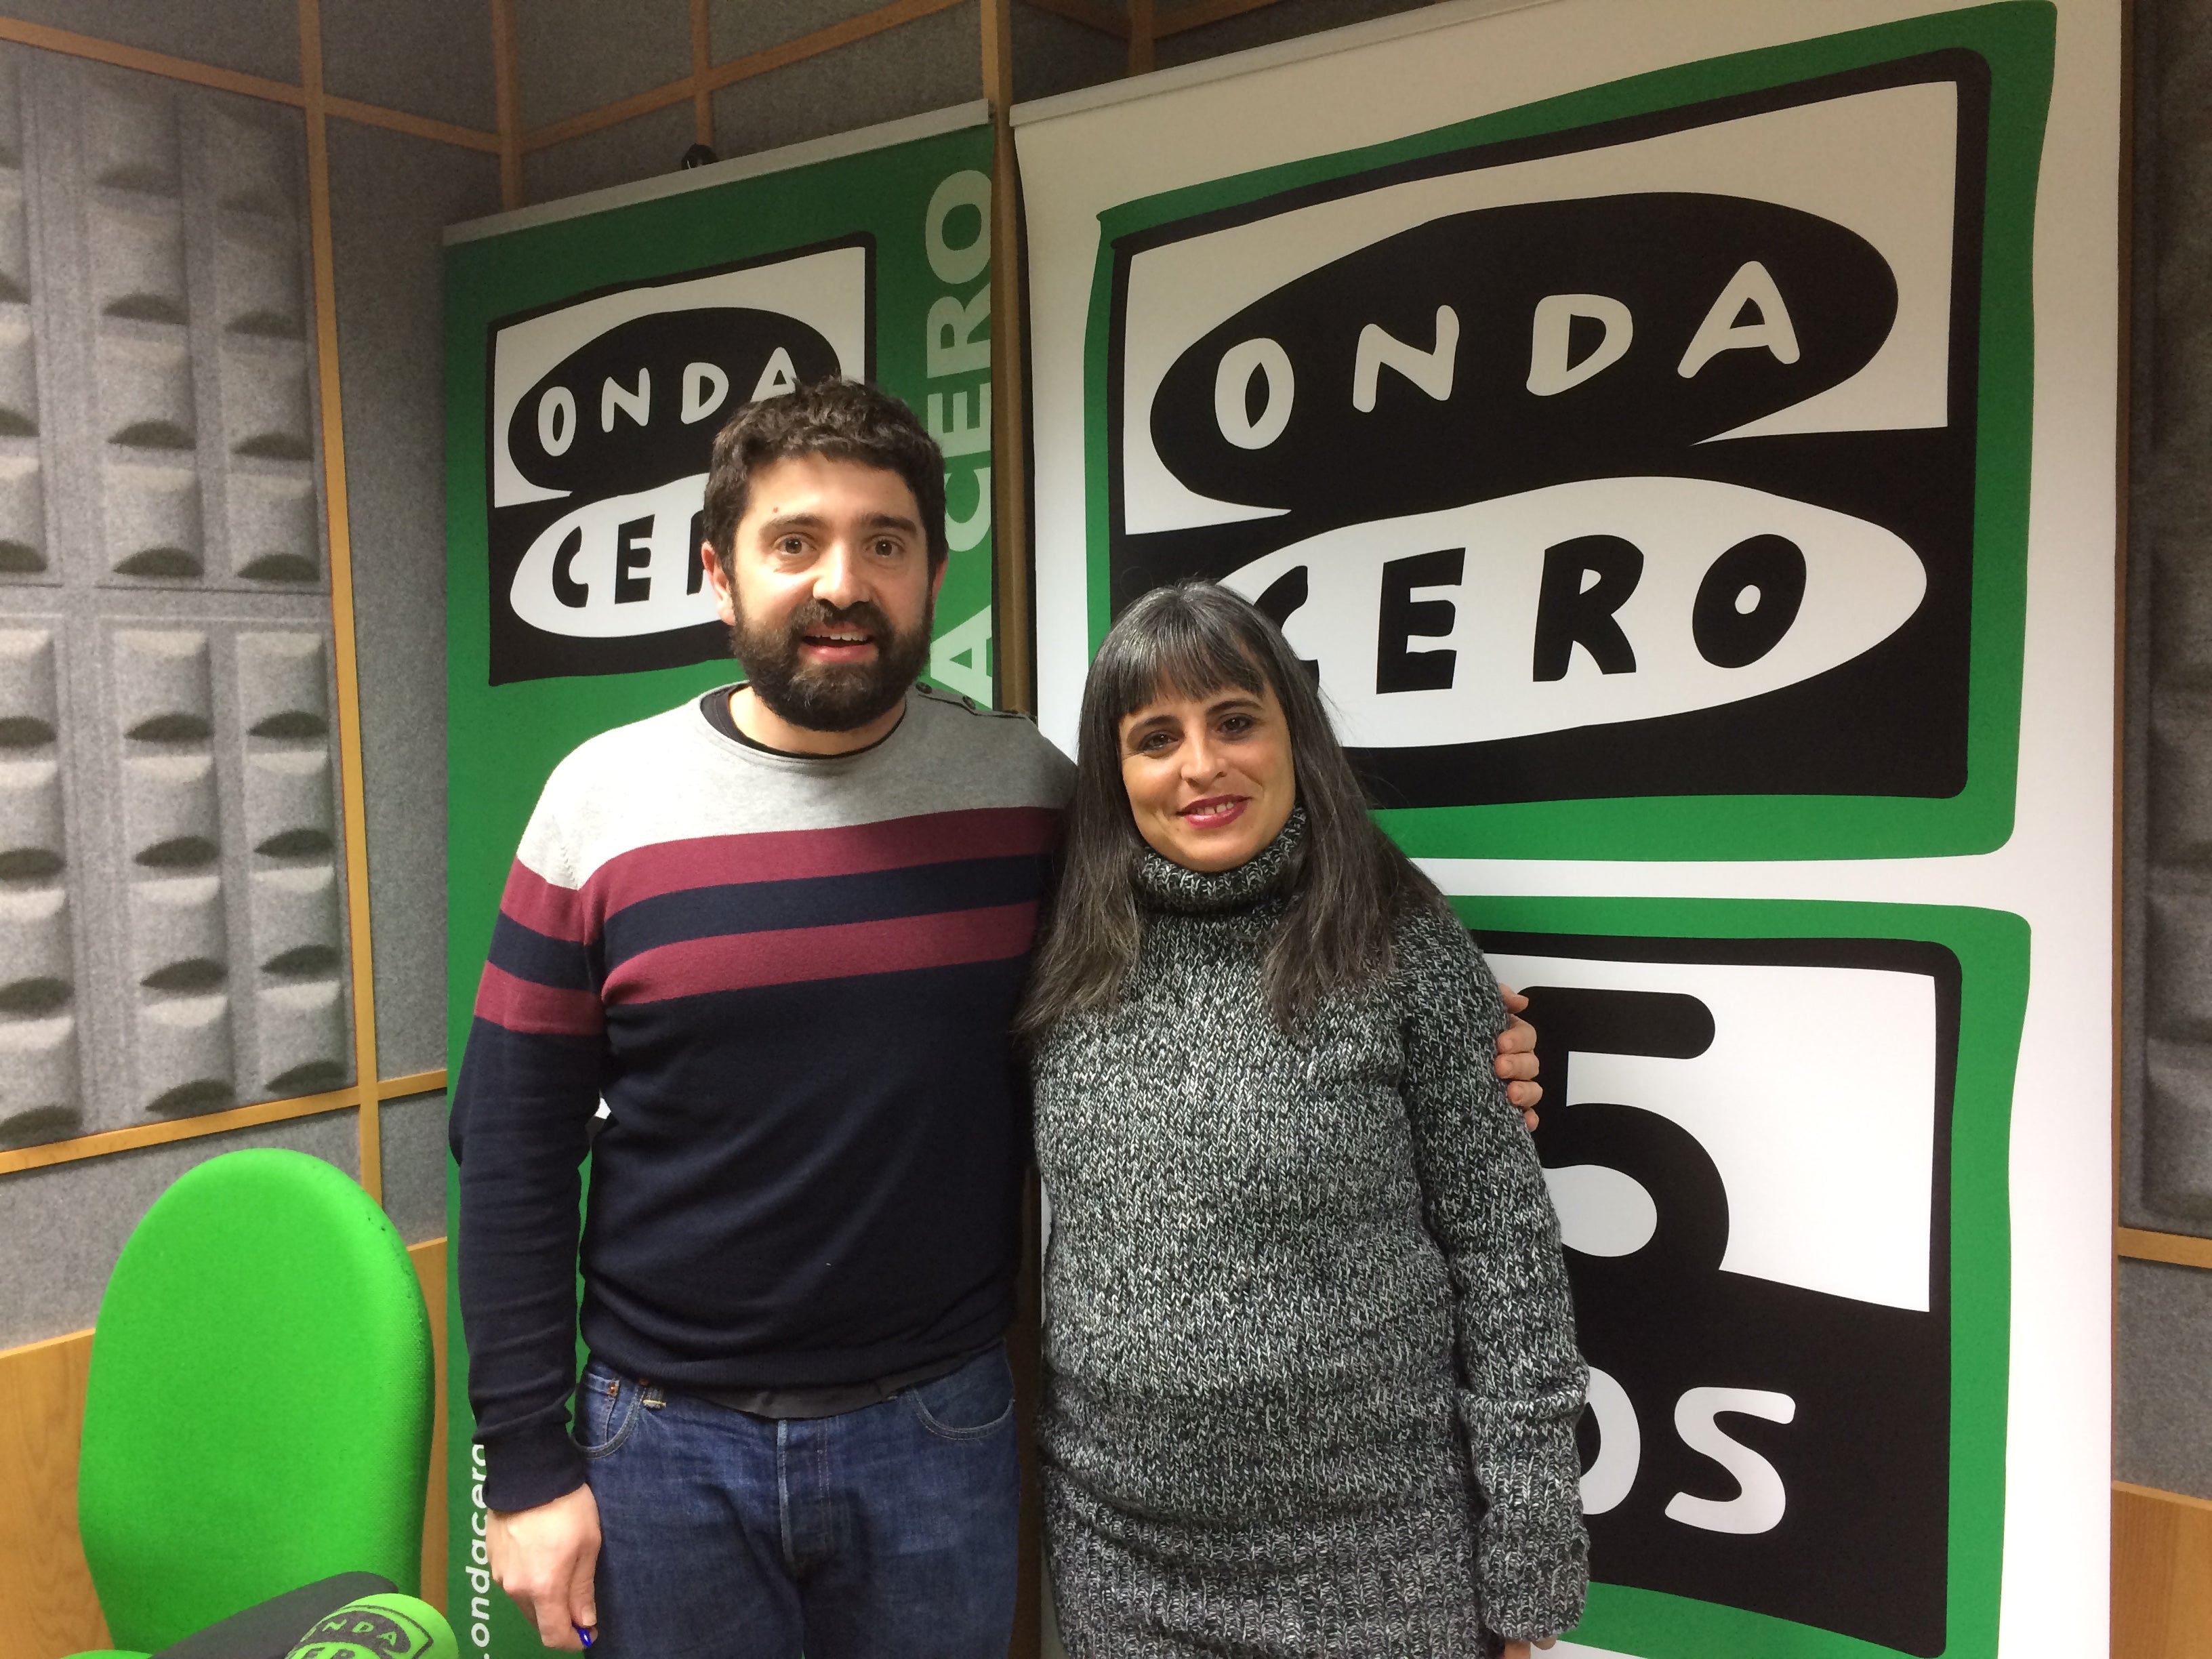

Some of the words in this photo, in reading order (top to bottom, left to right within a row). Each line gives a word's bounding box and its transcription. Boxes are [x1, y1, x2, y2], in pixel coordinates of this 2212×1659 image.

[537, 346, 796, 457] ONDA
[1215, 261, 1800, 449] ONDA
[302, 1619, 398, 1646] NDA
